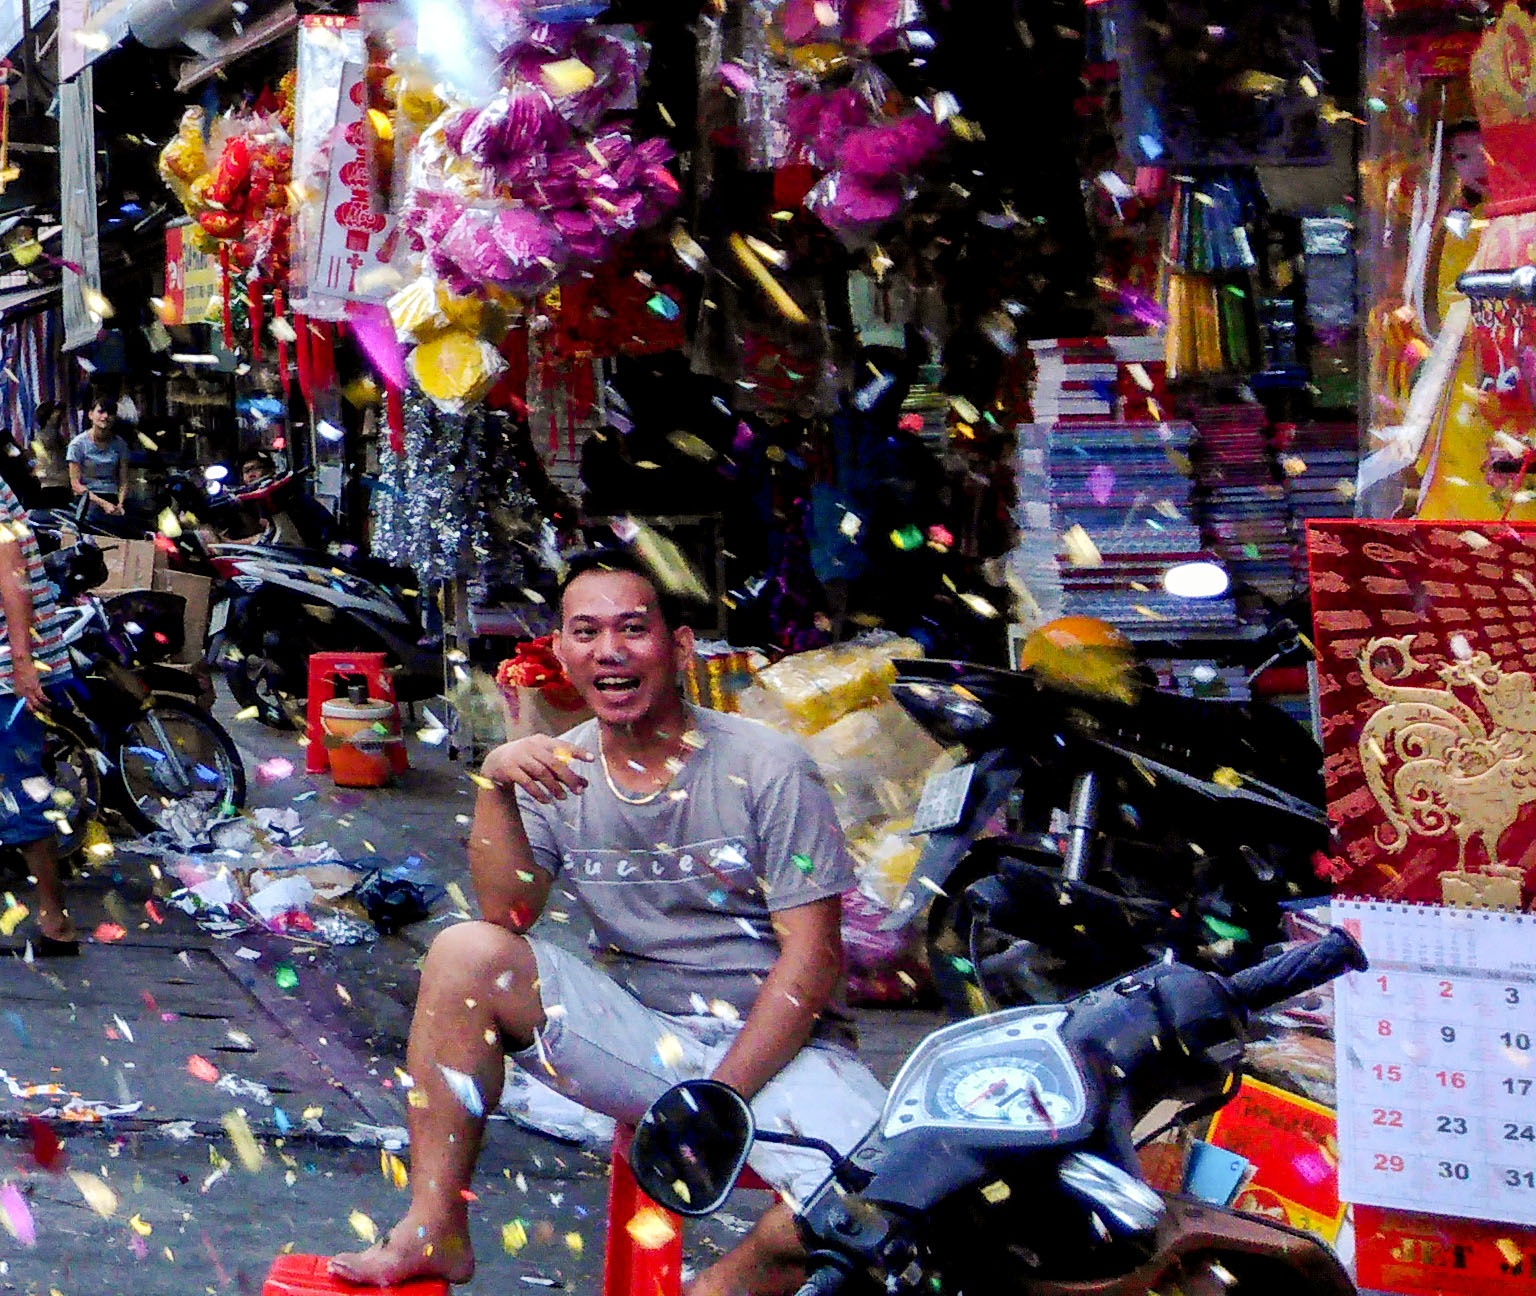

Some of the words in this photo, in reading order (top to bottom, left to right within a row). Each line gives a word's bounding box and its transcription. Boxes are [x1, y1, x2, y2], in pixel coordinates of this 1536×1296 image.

[1377, 975, 1388, 992] 1
[1439, 981, 1453, 998] 2
[1505, 987, 1520, 1004] 3
[1377, 1020, 1392, 1037] 8
[1440, 1026, 1456, 1043] 9
[1500, 1032, 1530, 1051] 10
[1372, 1064, 1402, 1082] 15
[1435, 1071, 1466, 1089] 16
[1502, 1078, 1532, 1096] 17
[1372, 1108, 1404, 1127] 22
[1436, 1116, 1468, 1135] 23
[1503, 1123, 1536, 1142] 24
[1373, 1153, 1405, 1172] 29
[1438, 1161, 1469, 1181] 30
[1505, 1169, 1535, 1188] 31
